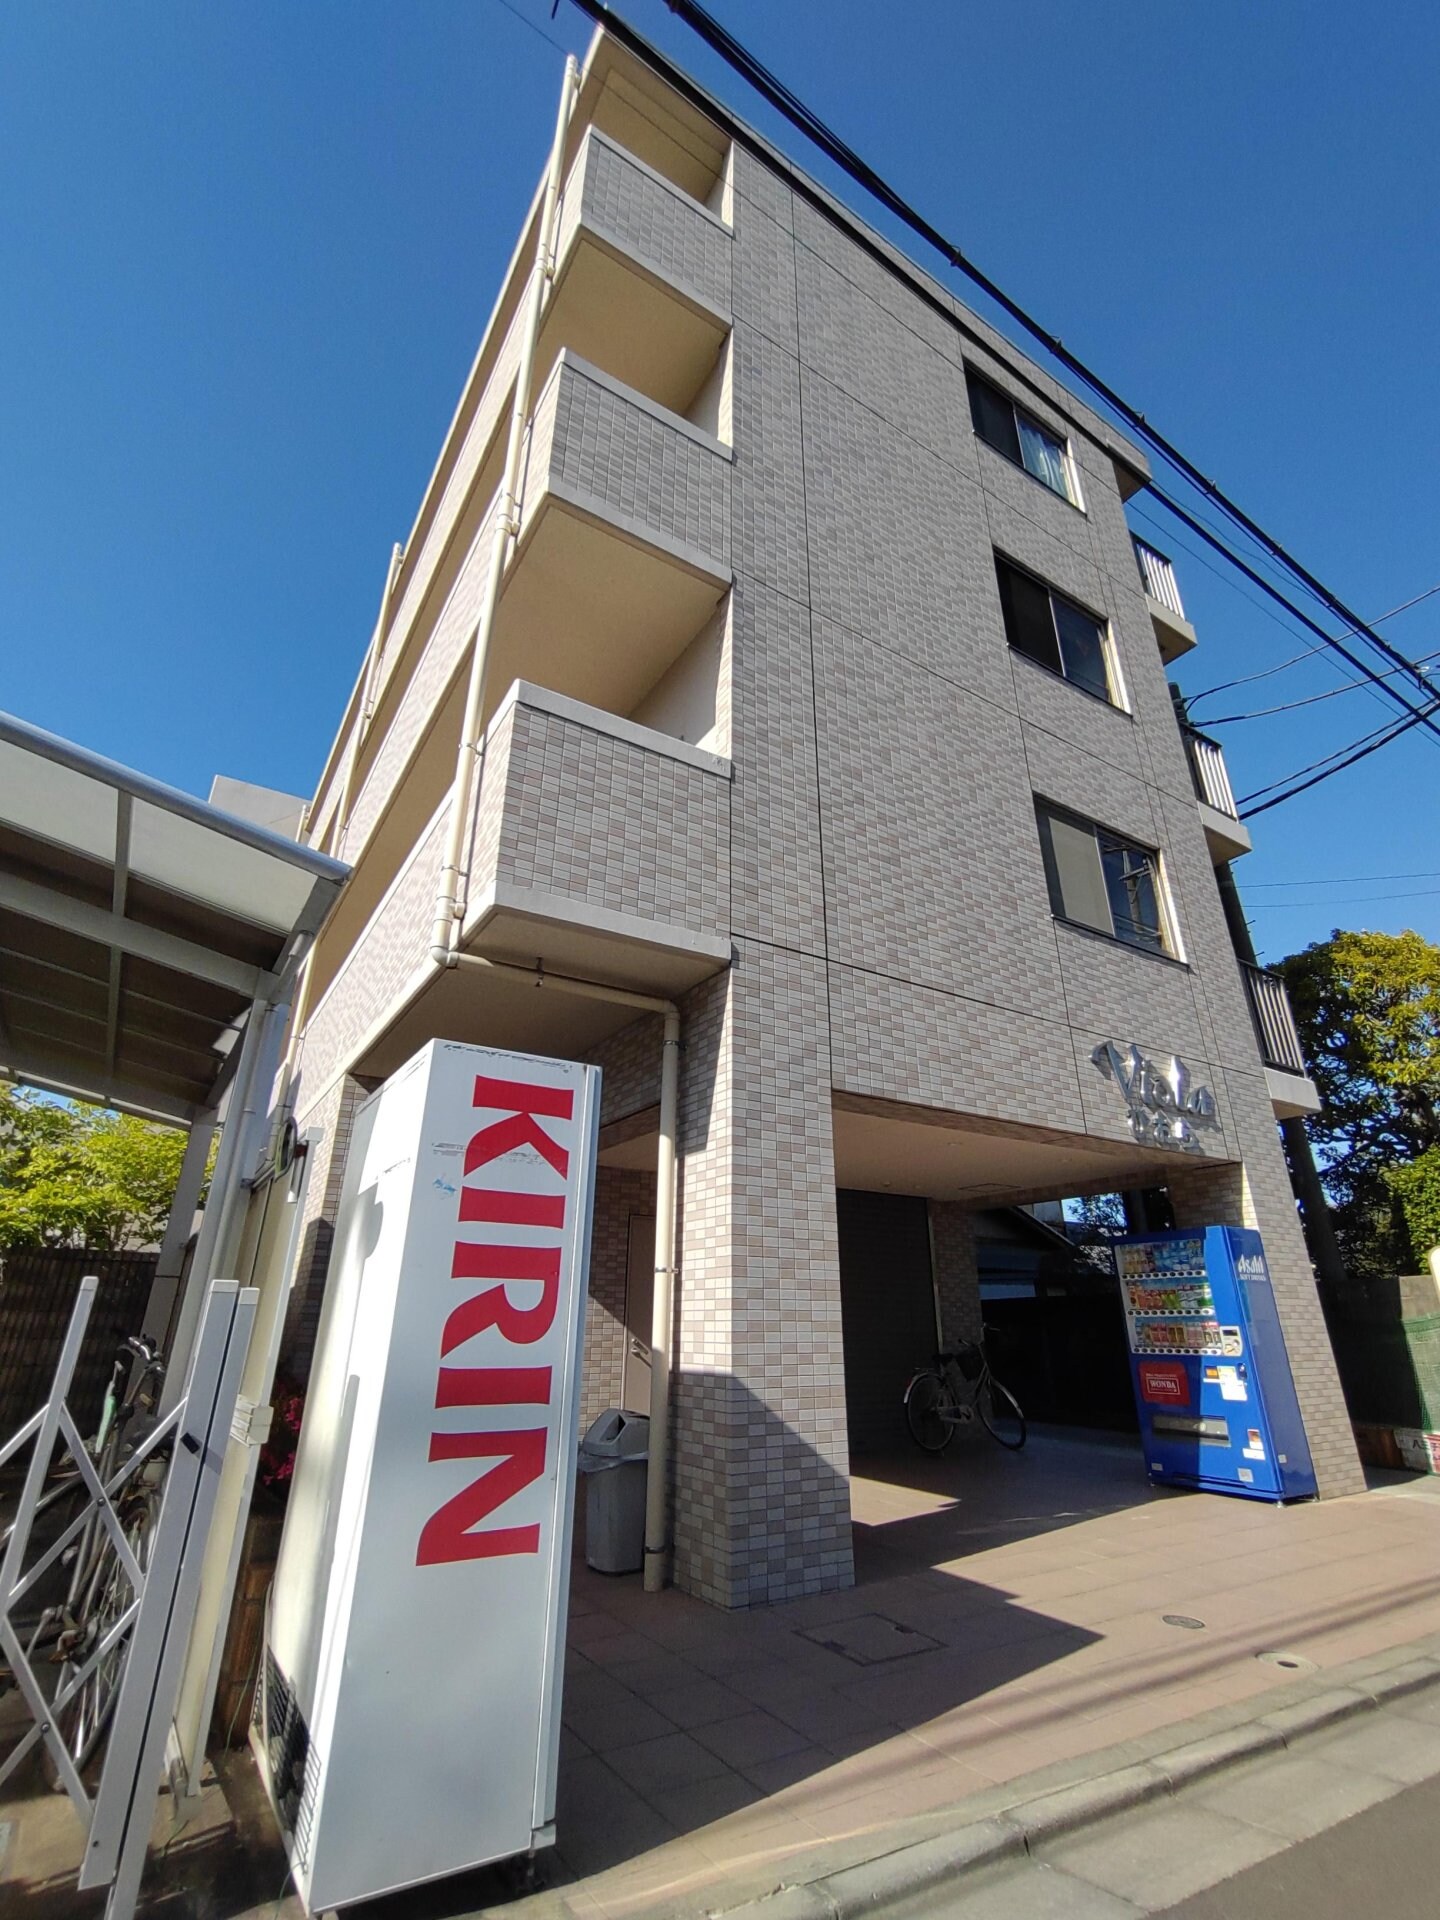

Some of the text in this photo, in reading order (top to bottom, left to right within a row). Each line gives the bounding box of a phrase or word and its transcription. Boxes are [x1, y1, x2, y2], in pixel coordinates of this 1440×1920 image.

[1088, 1041, 1211, 1115] Viola
[1238, 1254, 1264, 1273] Asahi
[416, 1074, 575, 1566] KIRIN
[1149, 1380, 1176, 1388] WONDA
